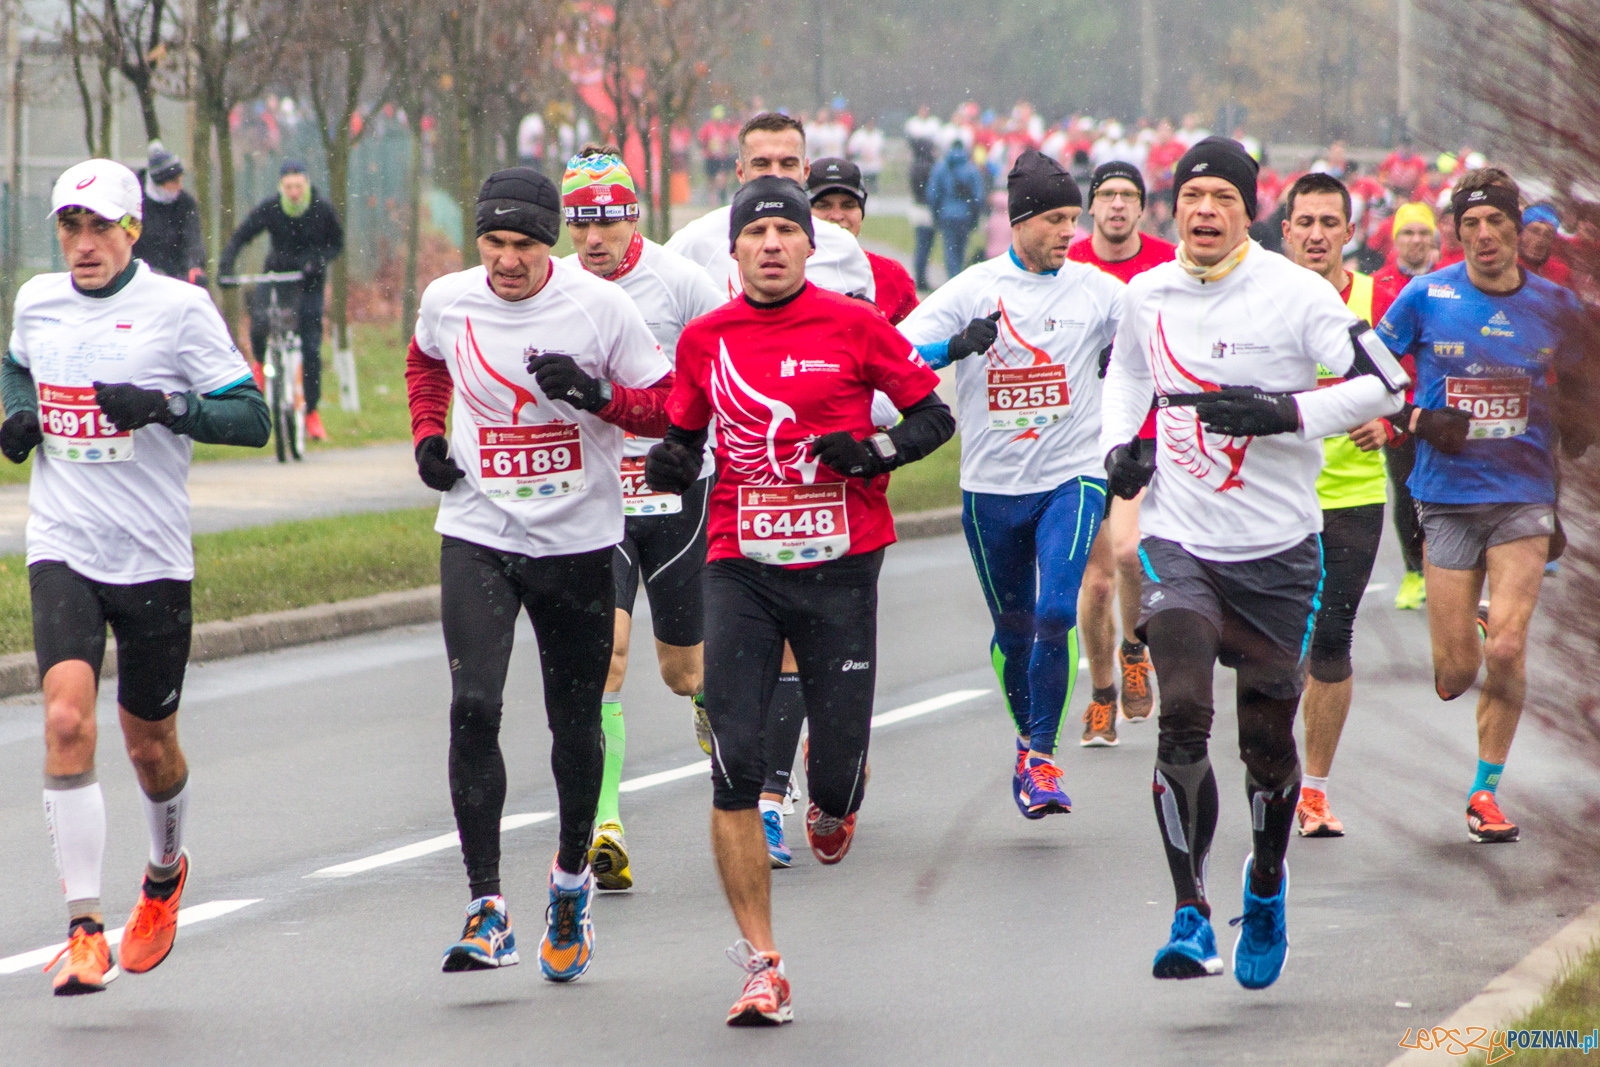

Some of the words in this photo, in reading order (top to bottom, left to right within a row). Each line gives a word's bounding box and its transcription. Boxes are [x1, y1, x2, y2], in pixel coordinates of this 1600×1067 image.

[996, 384, 1062, 409] 6255
[1457, 397, 1521, 419] 8055
[48, 408, 118, 437] 6919
[481, 458, 491, 468] B
[492, 446, 572, 476] 6189
[741, 520, 751, 530] B
[753, 509, 836, 538] 6448
